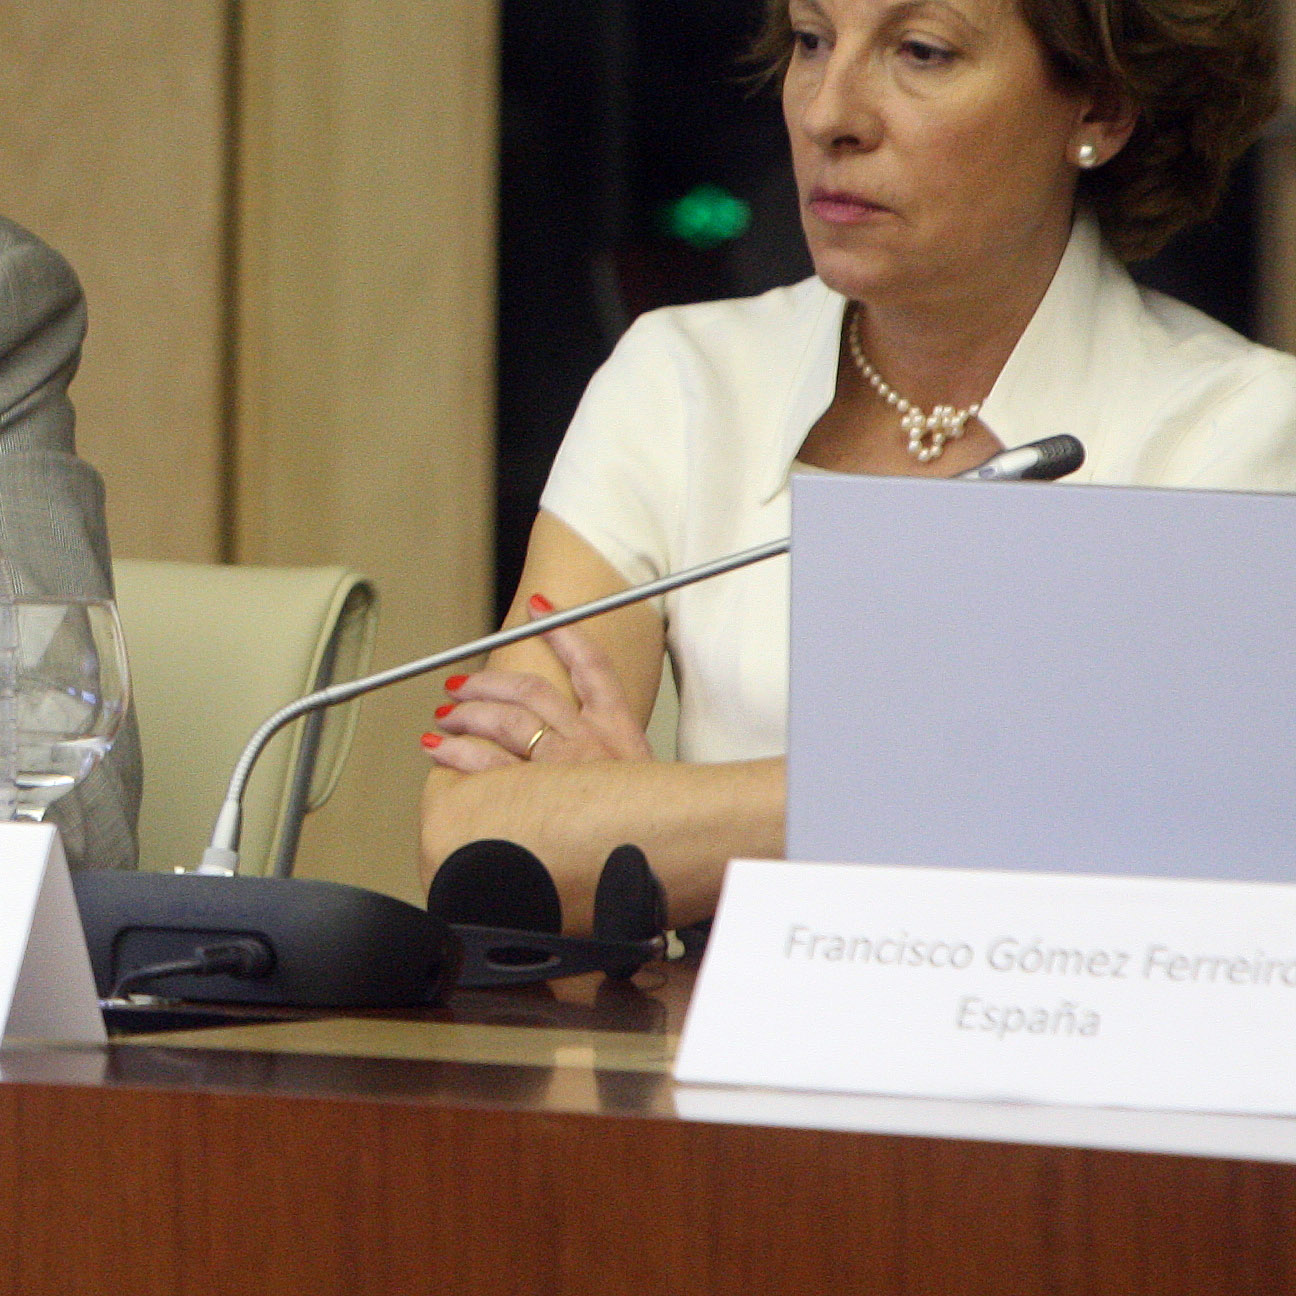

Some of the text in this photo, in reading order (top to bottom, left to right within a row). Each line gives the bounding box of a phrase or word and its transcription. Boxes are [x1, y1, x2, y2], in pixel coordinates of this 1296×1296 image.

[783, 923, 975, 970] Francisco
[986, 934, 1131, 979] Gómez
[955, 995, 1101, 1039] España
